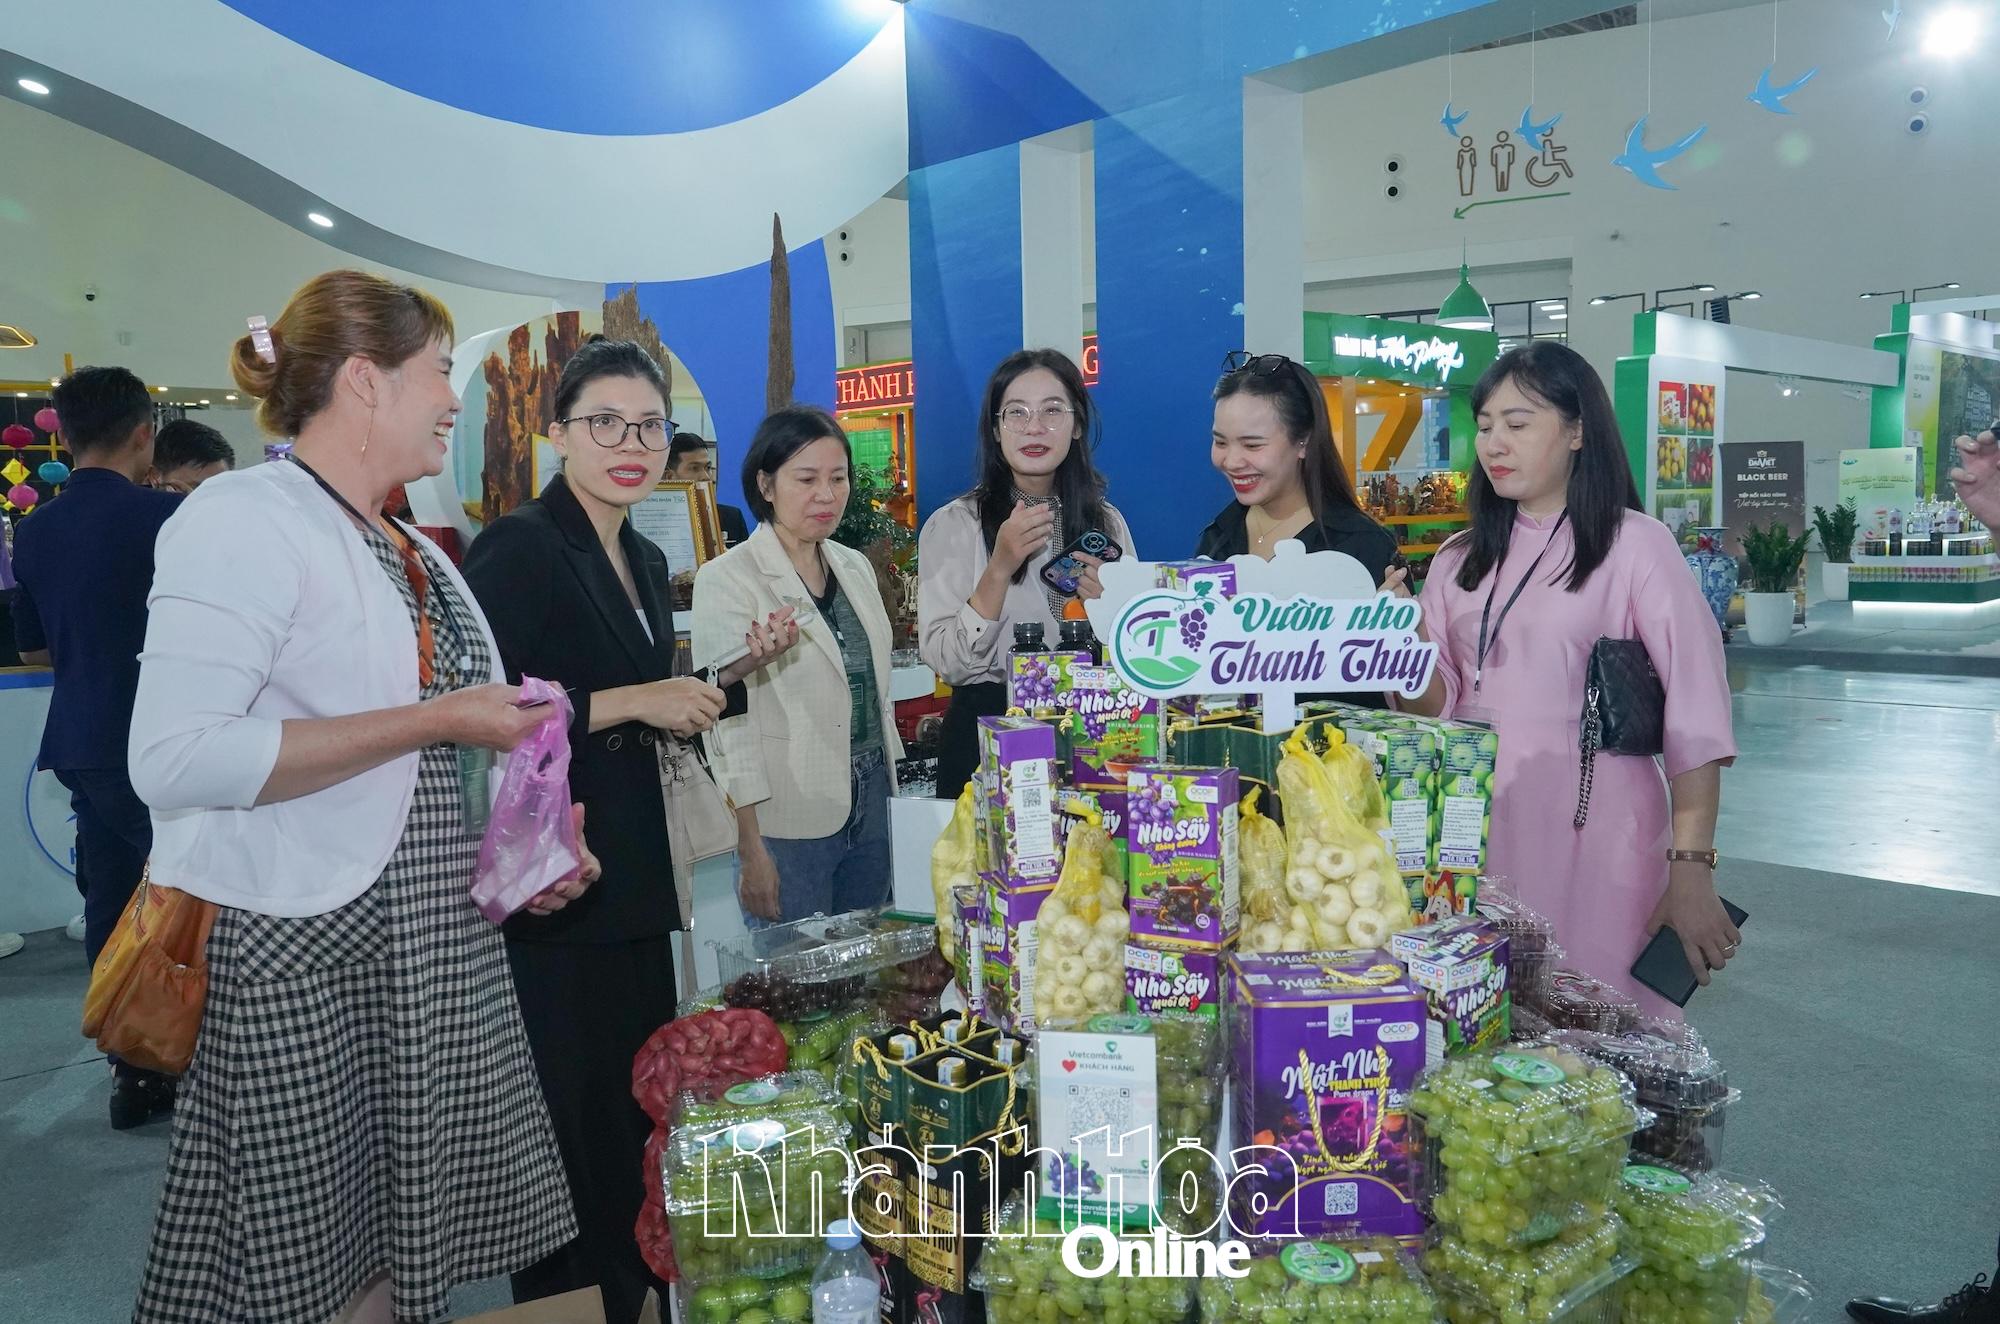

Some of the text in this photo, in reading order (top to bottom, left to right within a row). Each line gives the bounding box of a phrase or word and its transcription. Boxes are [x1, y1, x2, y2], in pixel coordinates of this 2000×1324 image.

[1233, 594, 1415, 632] Vườn nho
[1209, 636, 1433, 692] Thanh Thủy
[1080, 692, 1114, 714] Nho
[1137, 817, 1210, 845] Nho Sấy
[1133, 973, 1210, 1000] Nho Sấy
[1456, 987, 1485, 1019] Nho
[1068, 1051, 1123, 1060] Vietcombank
